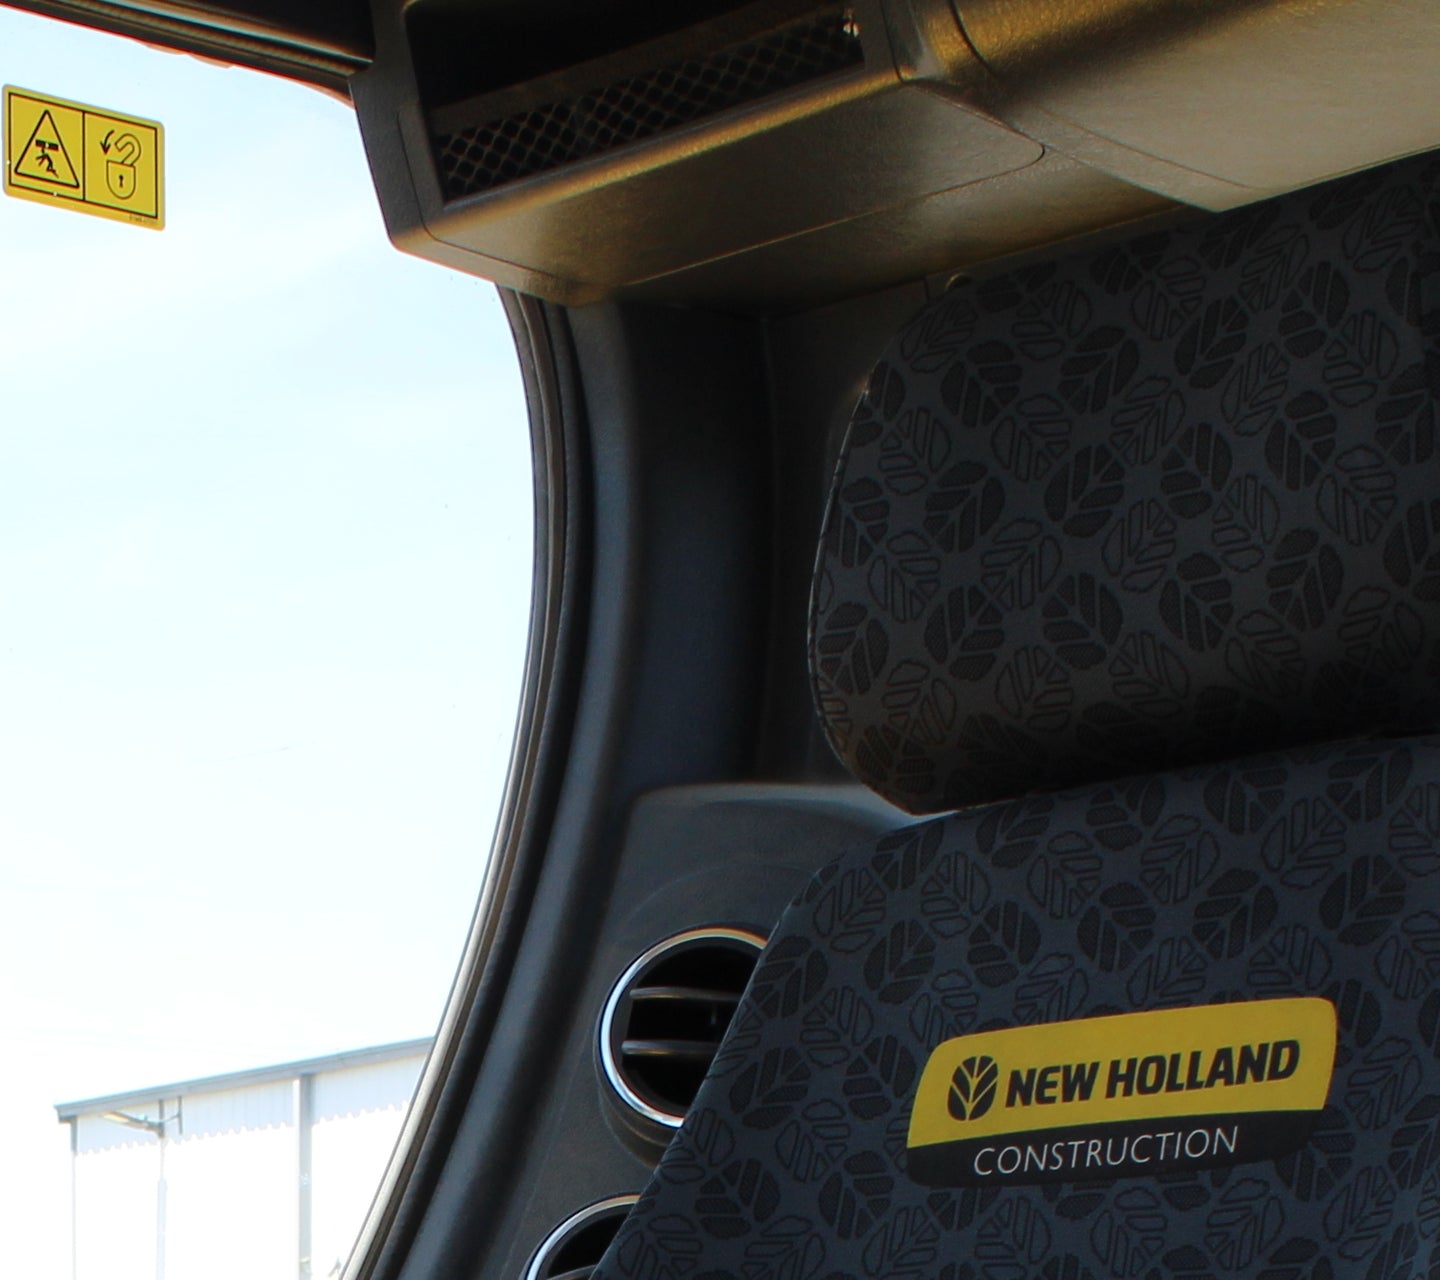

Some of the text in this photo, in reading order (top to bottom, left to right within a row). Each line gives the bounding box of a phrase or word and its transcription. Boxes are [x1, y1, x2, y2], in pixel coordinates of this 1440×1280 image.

[1005, 1039, 1301, 1108] NEW HOLLAND
[973, 1125, 1239, 1176] CONSTRUCTION
